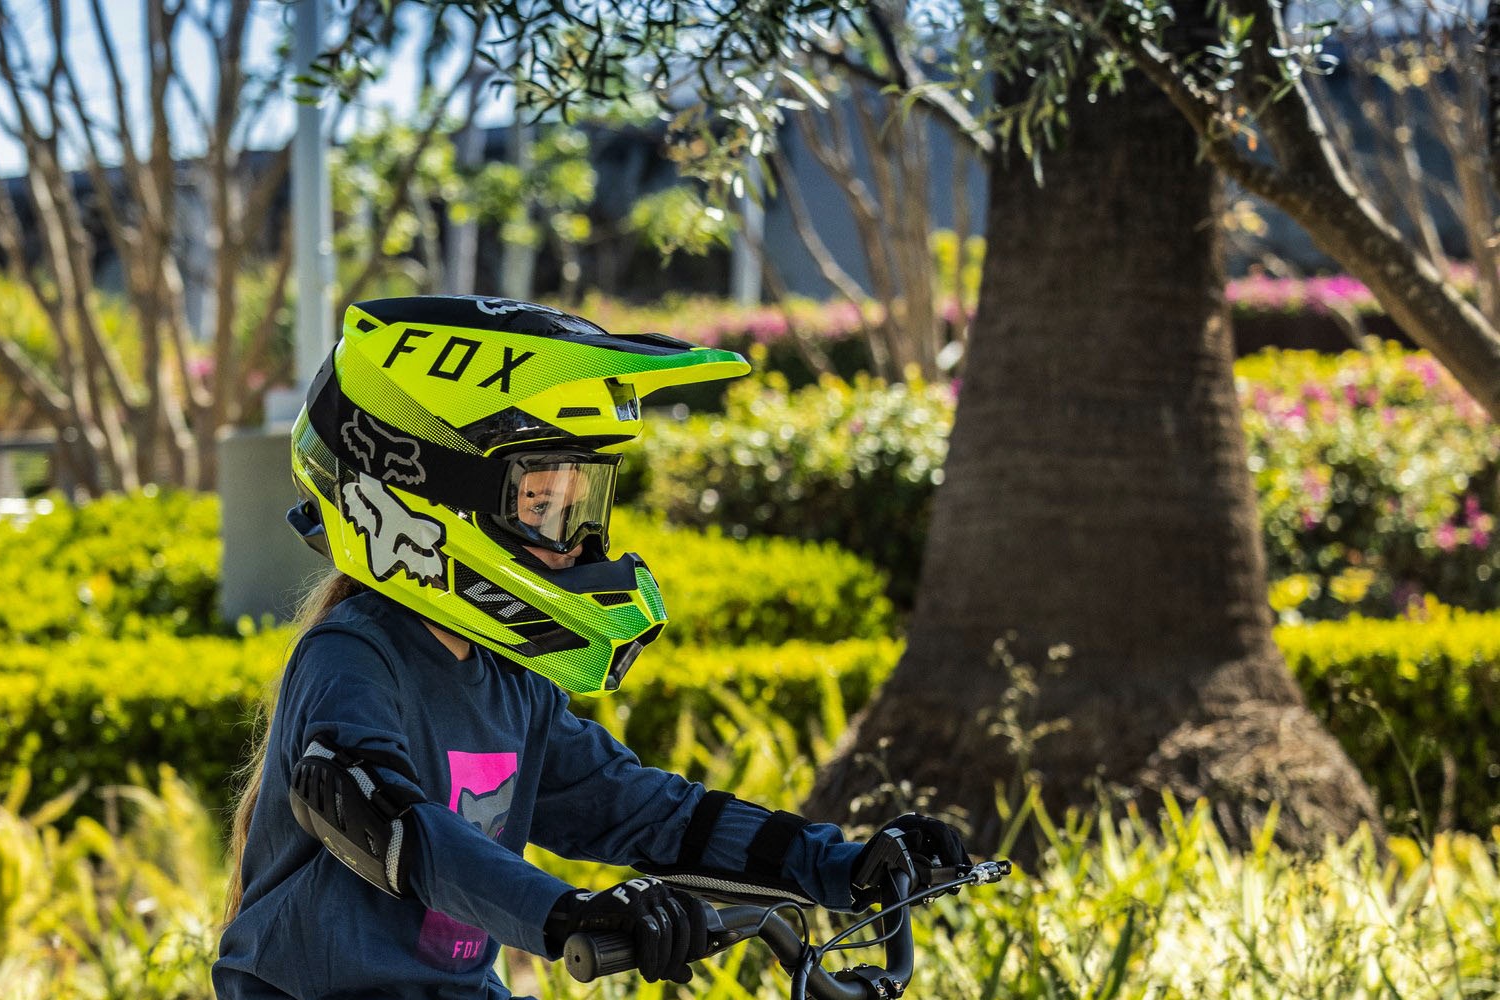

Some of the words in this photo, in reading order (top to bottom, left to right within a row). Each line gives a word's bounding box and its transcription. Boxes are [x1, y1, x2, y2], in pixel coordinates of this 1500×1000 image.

[382, 328, 537, 394] FOX
[463, 581, 528, 619] V1
[452, 941, 482, 959] FOX
